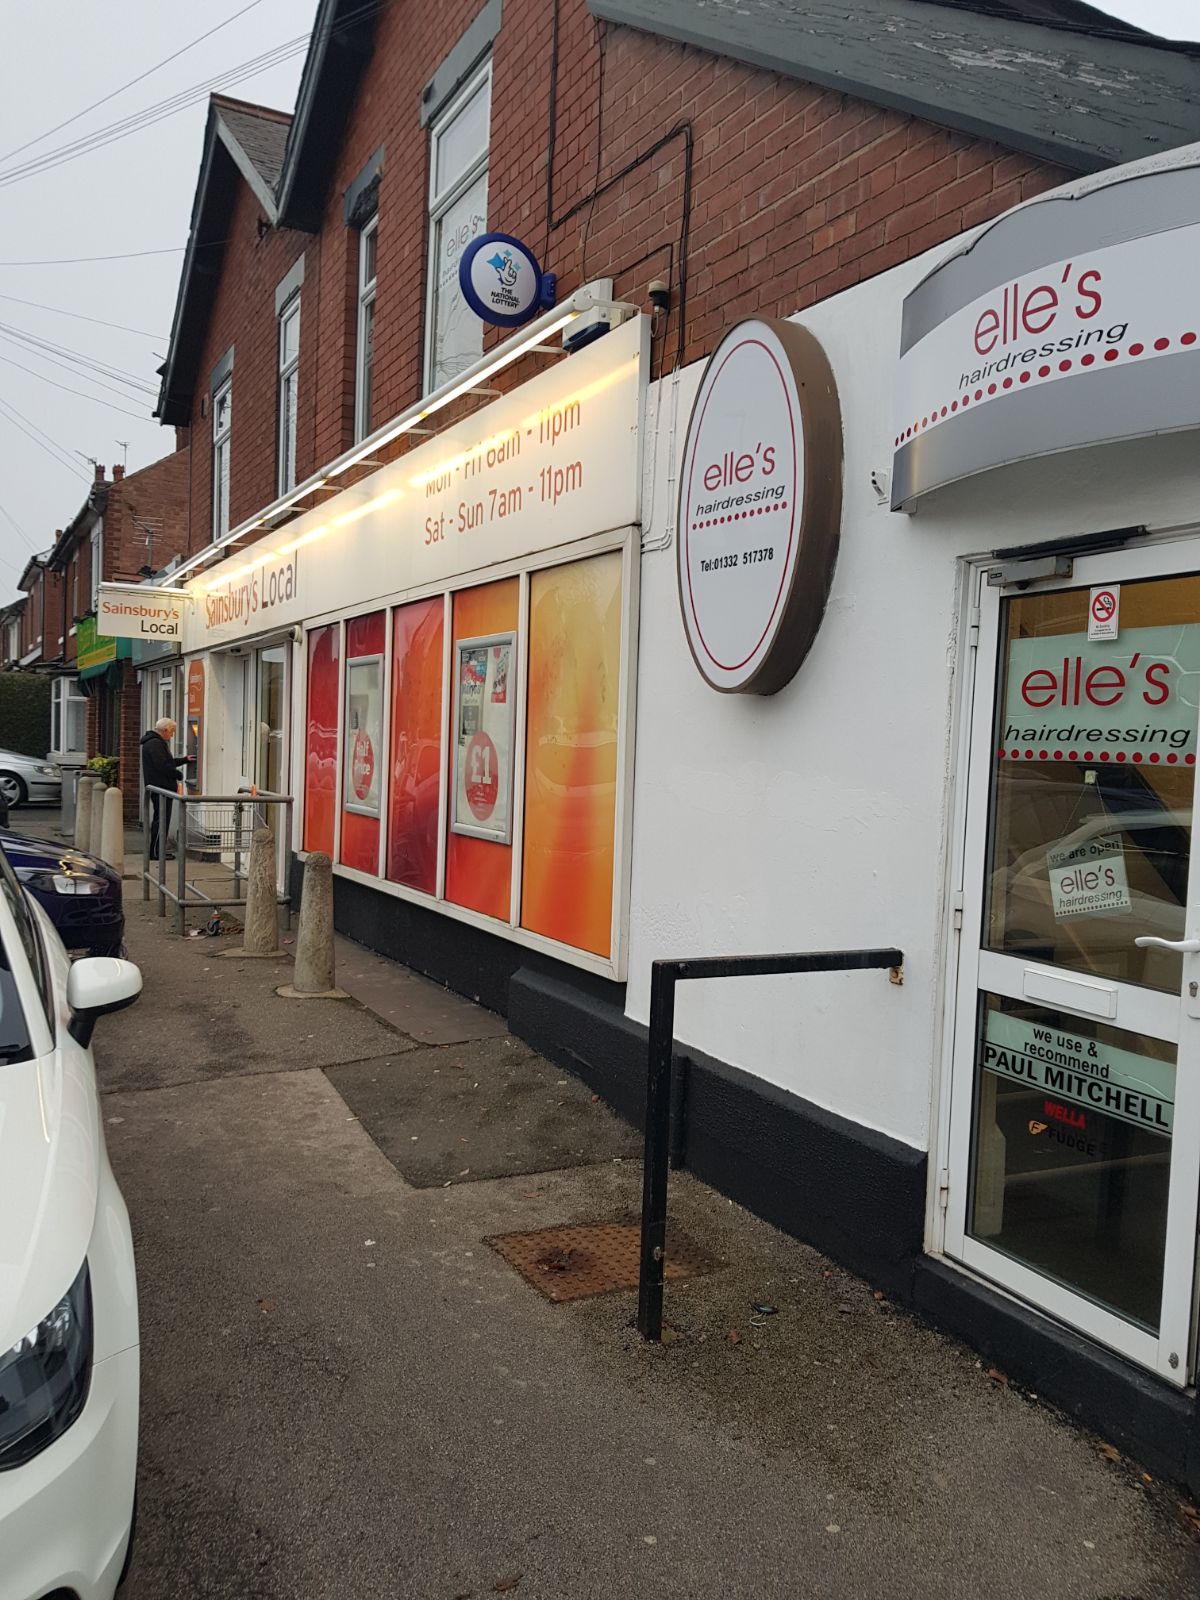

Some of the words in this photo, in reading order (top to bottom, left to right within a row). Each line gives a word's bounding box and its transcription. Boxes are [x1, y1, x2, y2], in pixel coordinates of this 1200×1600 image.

[490, 291, 520, 303] NATIONAL
[492, 297, 519, 308] LOTTERY
[974, 263, 1102, 356] elle's
[958, 322, 1129, 390] hairdressing
[703, 442, 776, 492] elle's
[424, 512, 445, 545] Sat
[458, 502, 484, 533] Sun
[488, 486, 522, 521] 7am
[539, 461, 583, 505] 11pm
[695, 485, 786, 516] hairdressing
[742, 547, 774, 565] 517378
[204, 574, 258, 629] Sainsbury's
[261, 549, 298, 609] Local
[102, 601, 180, 621] Sainsbury's
[140, 620, 178, 635] Local
[1021, 652, 1170, 708] elle's
[1005, 724, 1191, 749] hairdressing
[471, 744, 492, 785] £1
[1050, 853, 1066, 863] we
[1068, 847, 1087, 859] are
[1089, 840, 1120, 856] open
[1060, 865, 1115, 894] elle's
[1059, 890, 1122, 908] hairdressing
[1033, 1027, 1052, 1043] we
[1057, 1034, 1082, 1053] use
[1087, 1042, 1098, 1058] &
[1024, 1041, 1110, 1079] recommend
[984, 1045, 1038, 1081] PAUL
[1044, 1066, 1169, 1127] MITCHELL
[1043, 1100, 1086, 1130] WELLA
[1048, 1128, 1096, 1156] FUDGE
